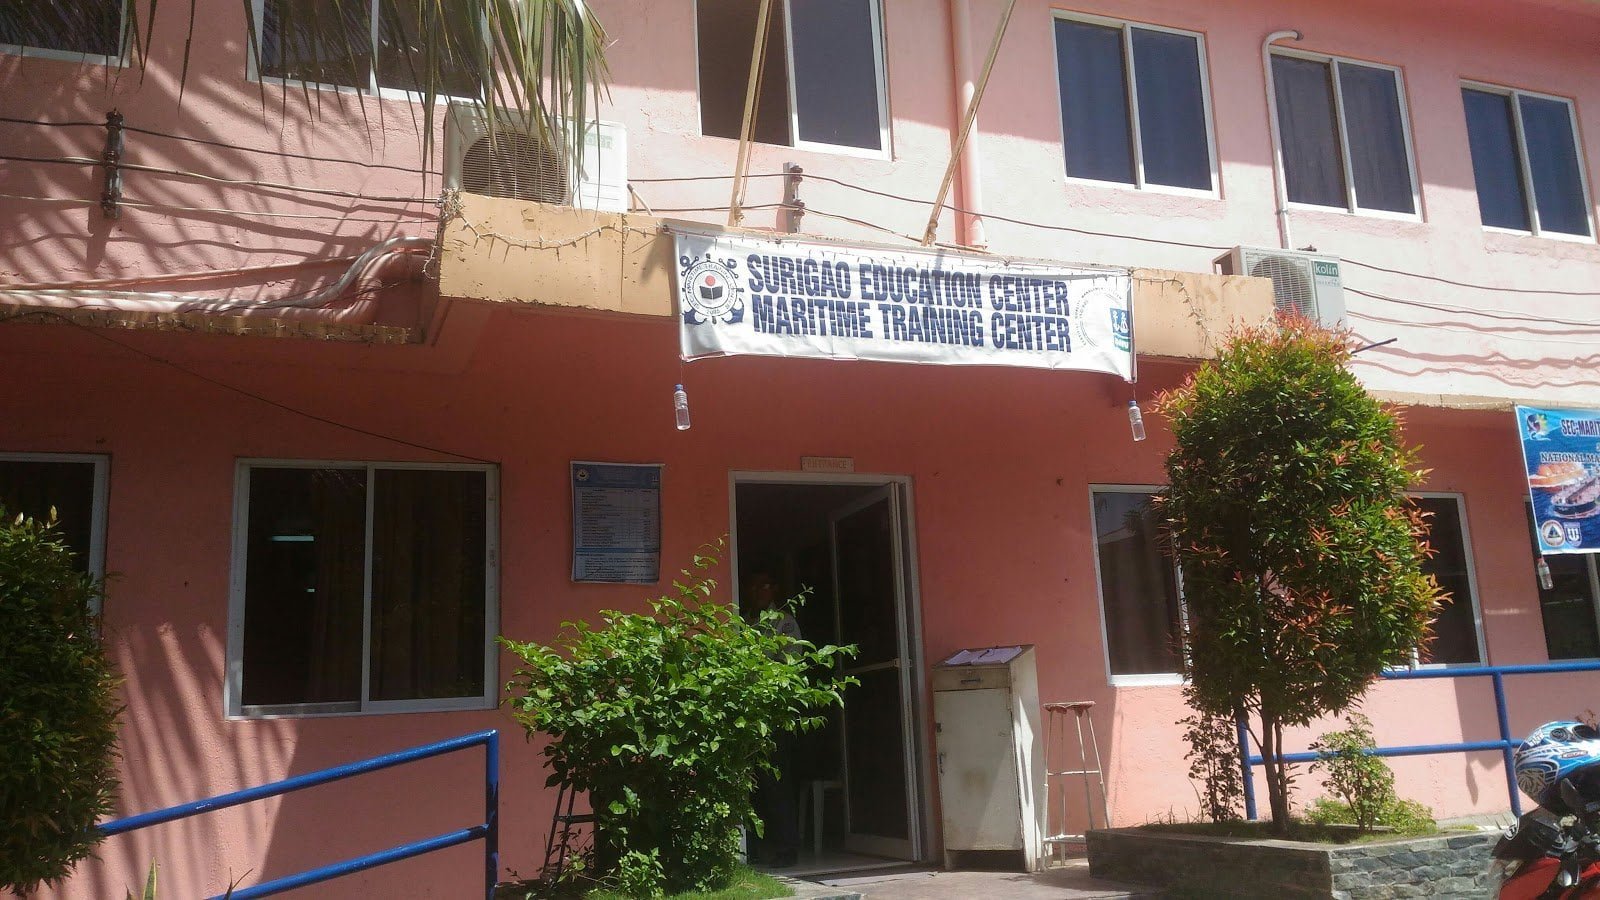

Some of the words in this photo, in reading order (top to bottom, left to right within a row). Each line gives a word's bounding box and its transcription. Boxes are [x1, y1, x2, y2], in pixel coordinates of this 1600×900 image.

[747, 253, 852, 299] SURIGAO
[859, 263, 983, 309] EDUCATION
[989, 274, 1070, 317] CENTER
[1315, 262, 1338, 276] kolin
[751, 294, 873, 338] MARITIME
[878, 303, 984, 348] TRAINING
[990, 311, 1072, 353] CENTER
[1541, 453, 1584, 463] NATIONAL
